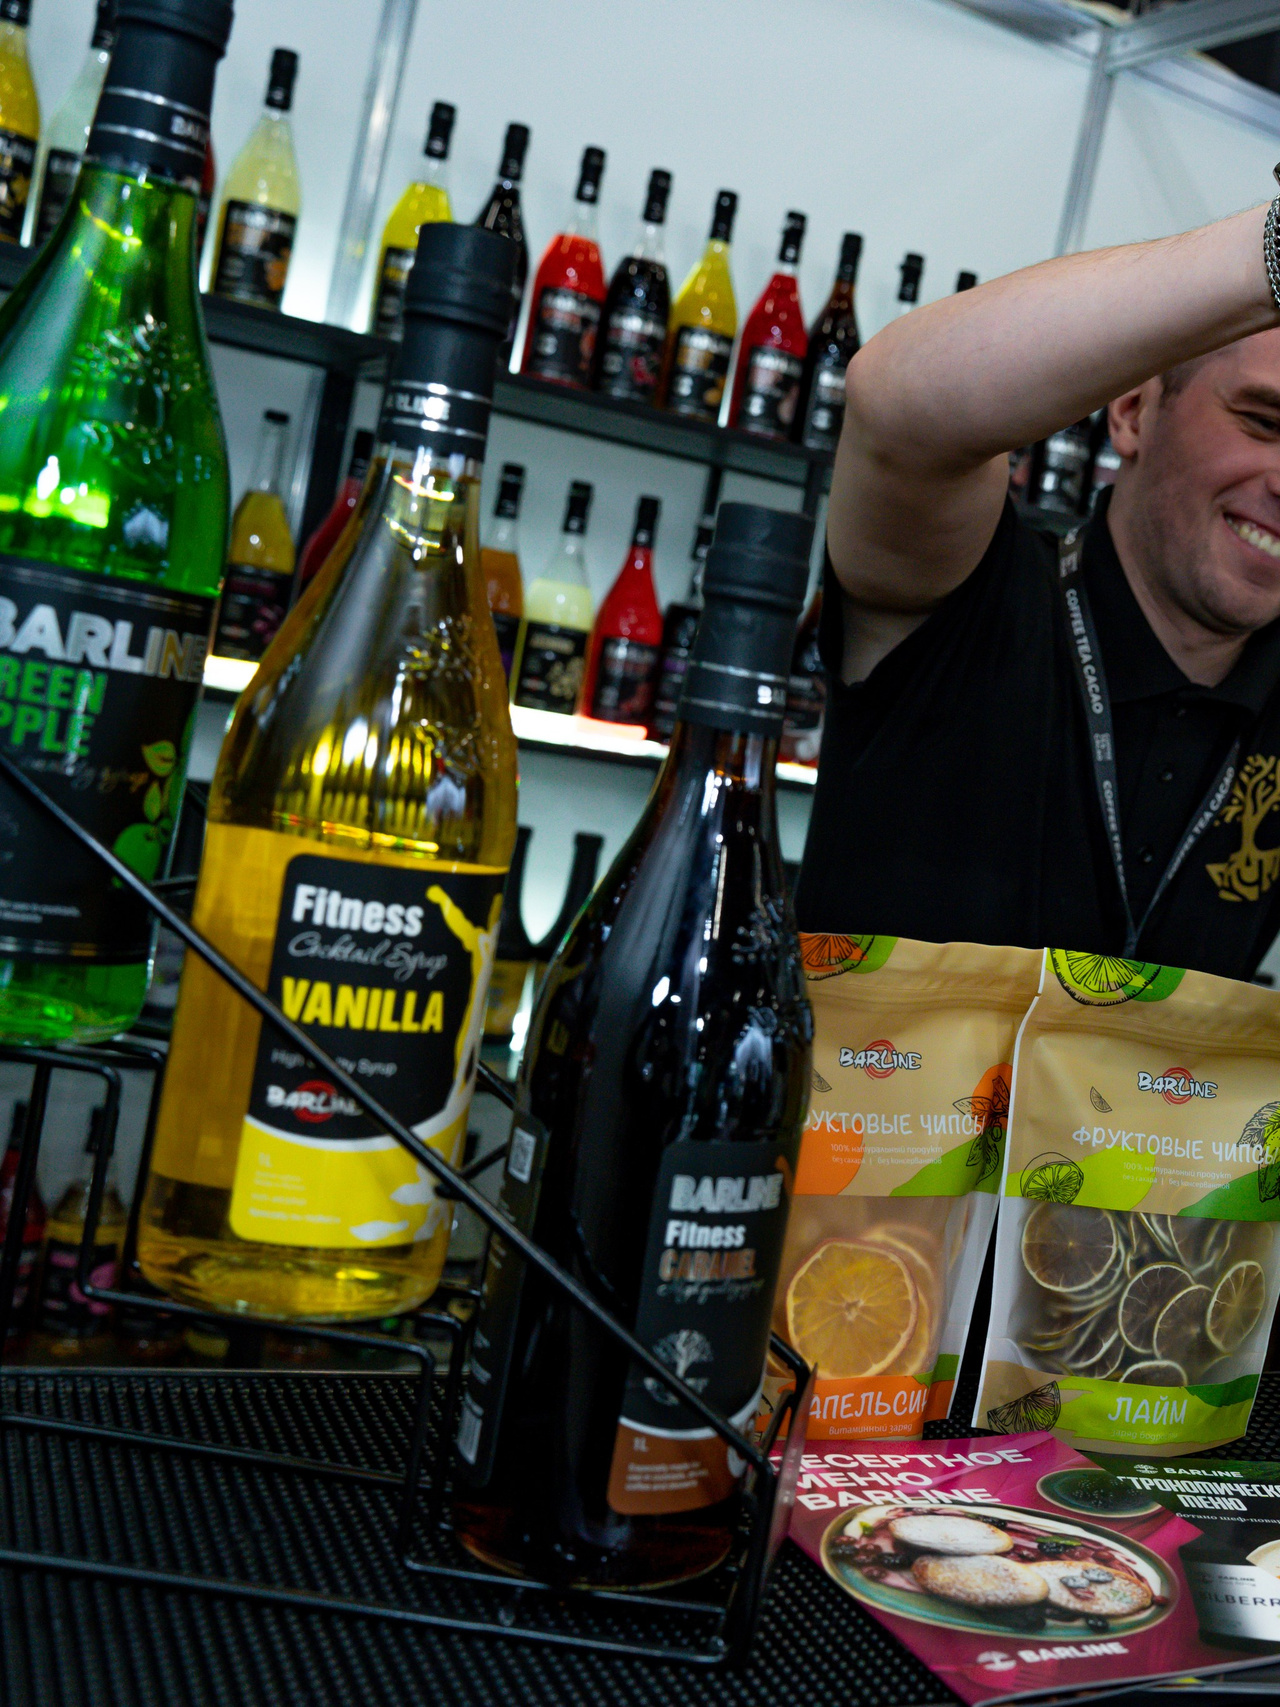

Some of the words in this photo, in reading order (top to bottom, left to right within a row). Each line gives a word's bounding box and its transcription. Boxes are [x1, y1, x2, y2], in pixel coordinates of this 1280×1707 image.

[1065, 588, 1086, 637] COFFEE
[1076, 634, 1093, 665] TEA
[1082, 664, 1104, 715] CACAO
[292, 883, 424, 938] Fitness
[288, 930, 391, 966] Cocktail
[384, 941, 448, 982] Syrup
[281, 975, 444, 1034] VANILLA
[920, 1113, 986, 1136] ЧИПСЫ
[830, 1143, 850, 1153] 100%
[1072, 1126, 1205, 1161] ФРУКТОВЫЕ
[1211, 1141, 1279, 1166] ЧИПСЫ
[668, 1173, 784, 1214] BARLINE
[664, 1219, 747, 1248] Fitness
[1107, 1395, 1188, 1425] ЛАЙМ
[1163, 1467, 1244, 1478] BARLINE
[796, 1488, 1001, 1512] BARLINE
[1176, 1494, 1248, 1512] МЕНЮ
[1017, 1642, 1130, 1663] BARLINE
